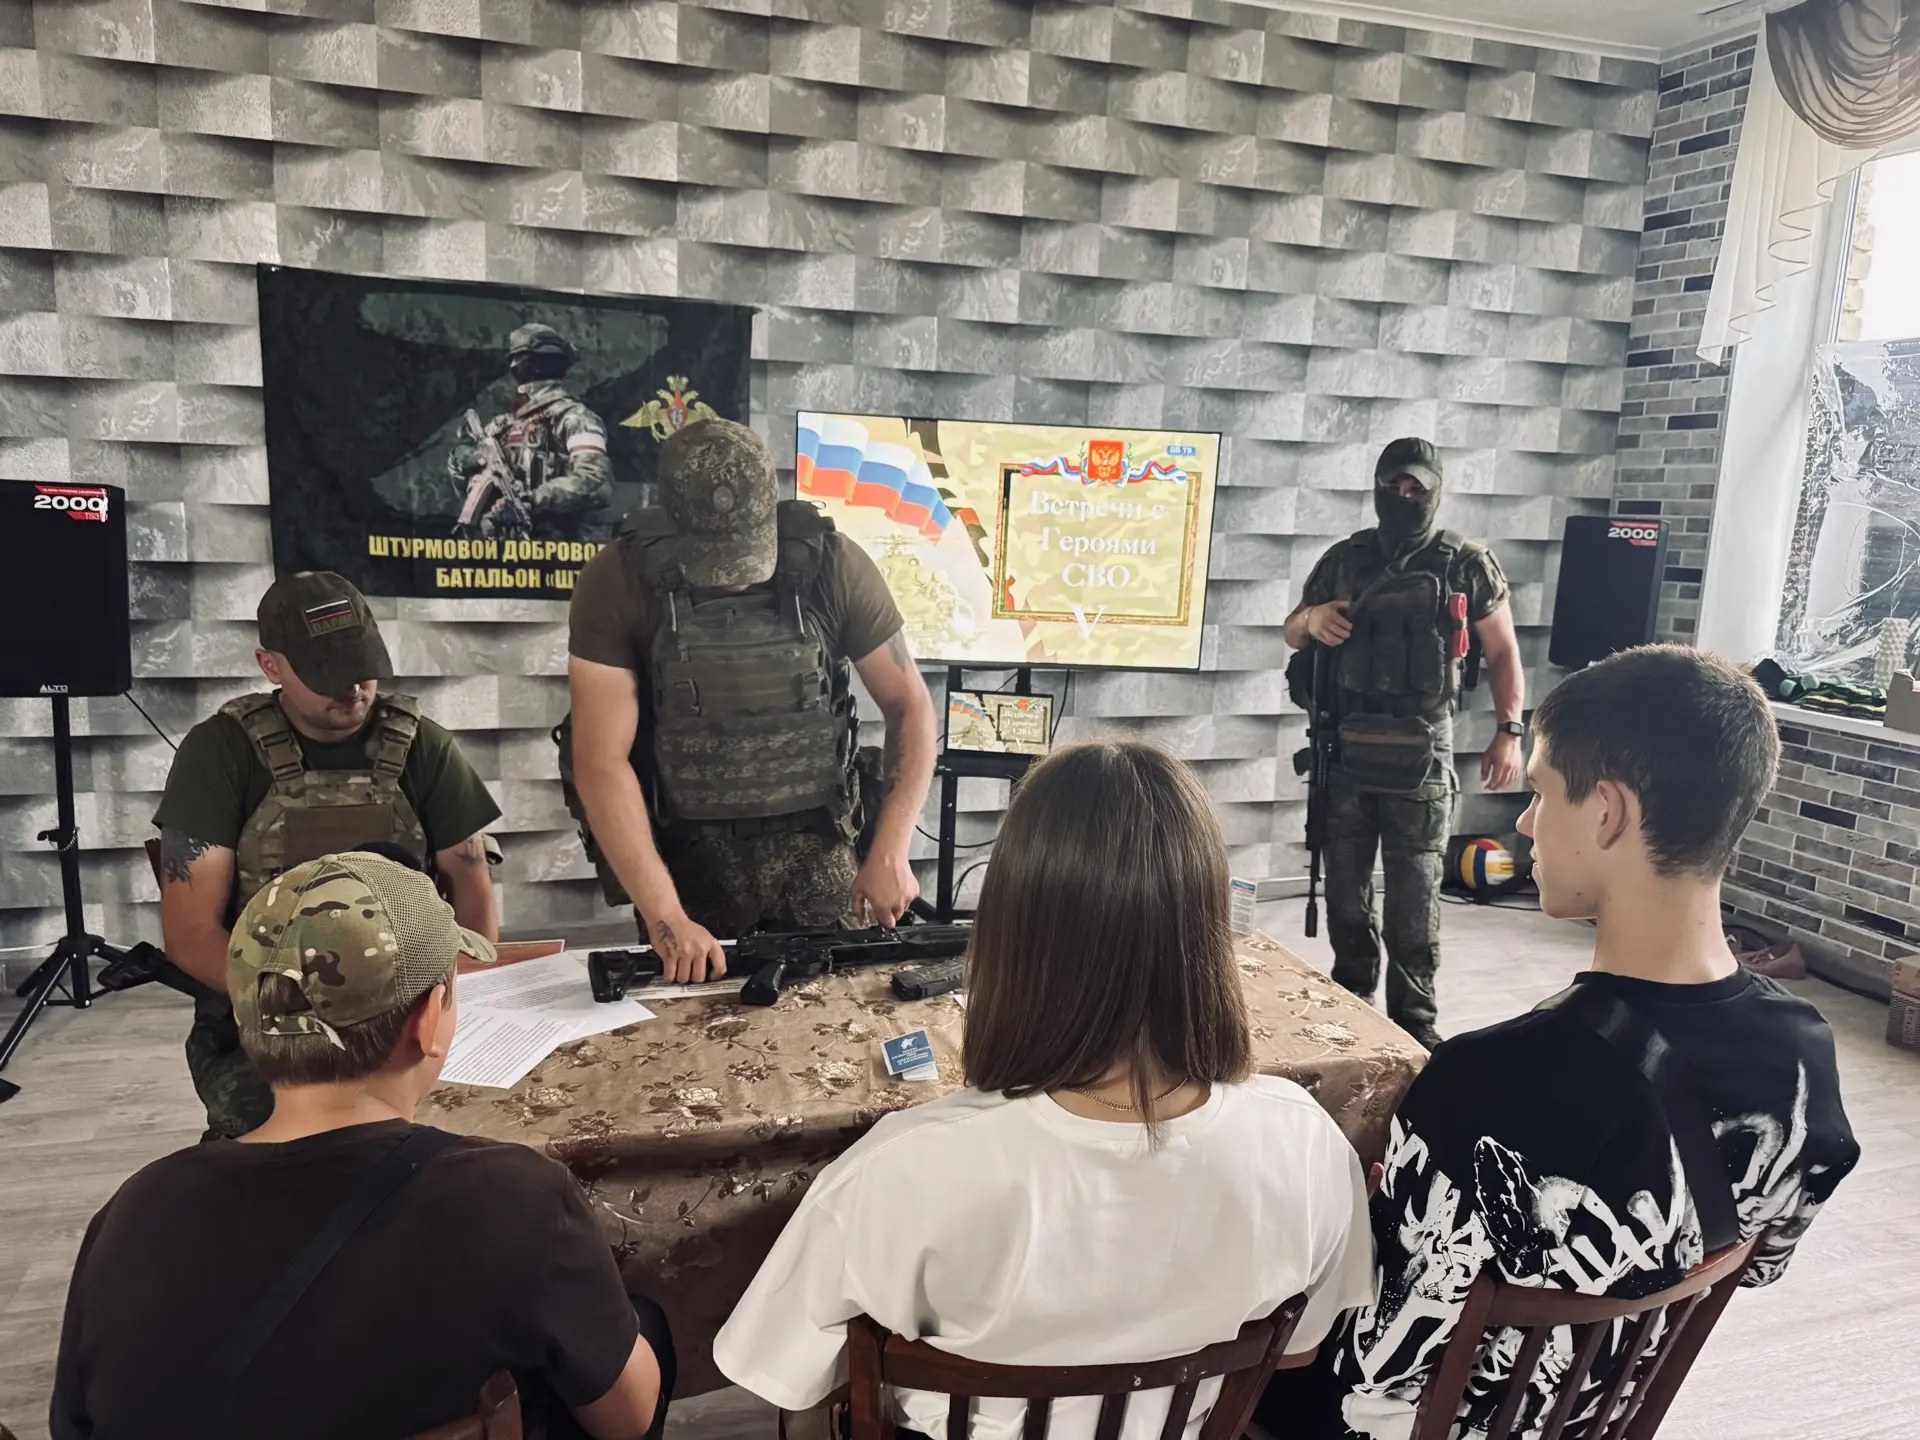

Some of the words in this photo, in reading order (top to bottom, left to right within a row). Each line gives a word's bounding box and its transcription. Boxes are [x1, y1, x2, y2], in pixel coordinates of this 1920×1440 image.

[1029, 489, 1142, 522] Встречи
[1151, 504, 1167, 520] с
[1041, 527, 1157, 557] Героями
[1607, 527, 1658, 540] 2000
[369, 535, 498, 560] ШТУРМОВОЙ
[503, 540, 607, 563] ДОБРОВО
[436, 567, 541, 588] БАТАЛЬОН
[545, 570, 580, 589] «Ш
[1062, 562, 1131, 588] СВО
[1068, 603, 1109, 640] V
